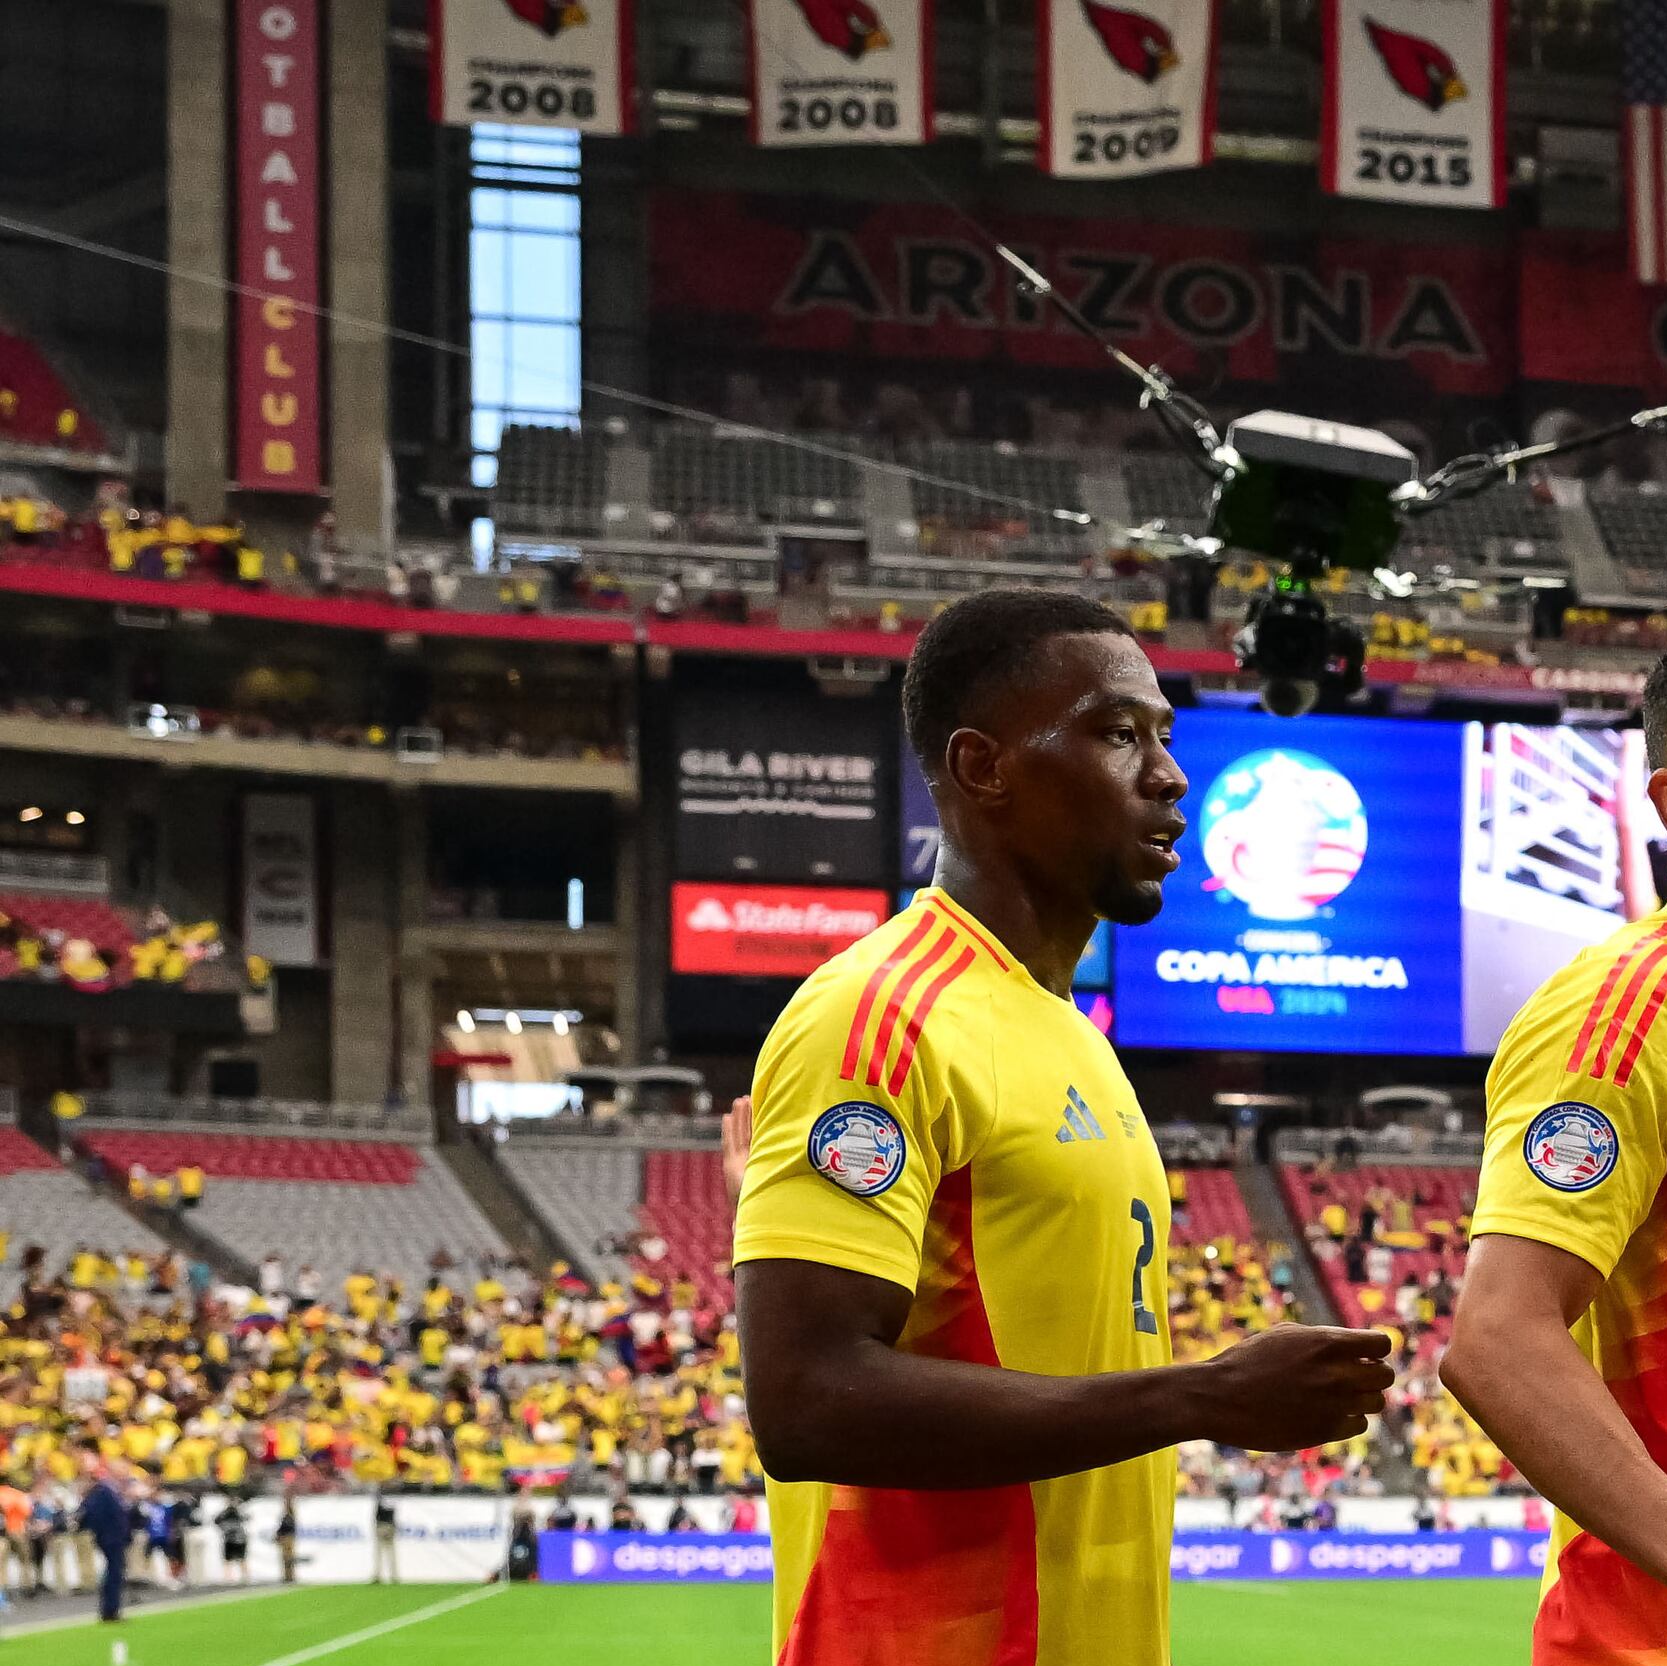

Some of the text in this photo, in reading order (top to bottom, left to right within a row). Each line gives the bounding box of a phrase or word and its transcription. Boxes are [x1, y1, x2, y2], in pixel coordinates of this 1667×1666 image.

[467, 80, 596, 118] 2008
[778, 98, 898, 131] 2008
[258, 5, 298, 282] OTBALL
[1074, 126, 1180, 164] 2009
[1356, 149, 1473, 187] 2015
[771, 229, 1488, 362] ARIZONA
[261, 296, 298, 475] CLUB
[680, 749, 876, 783] GILA RIVER
[1156, 949, 1409, 990] COPA AMERICA
[1130, 1196, 1159, 1336] 2
[1171, 1544, 1244, 1575] egar
[1308, 1541, 1464, 1574] despegar
